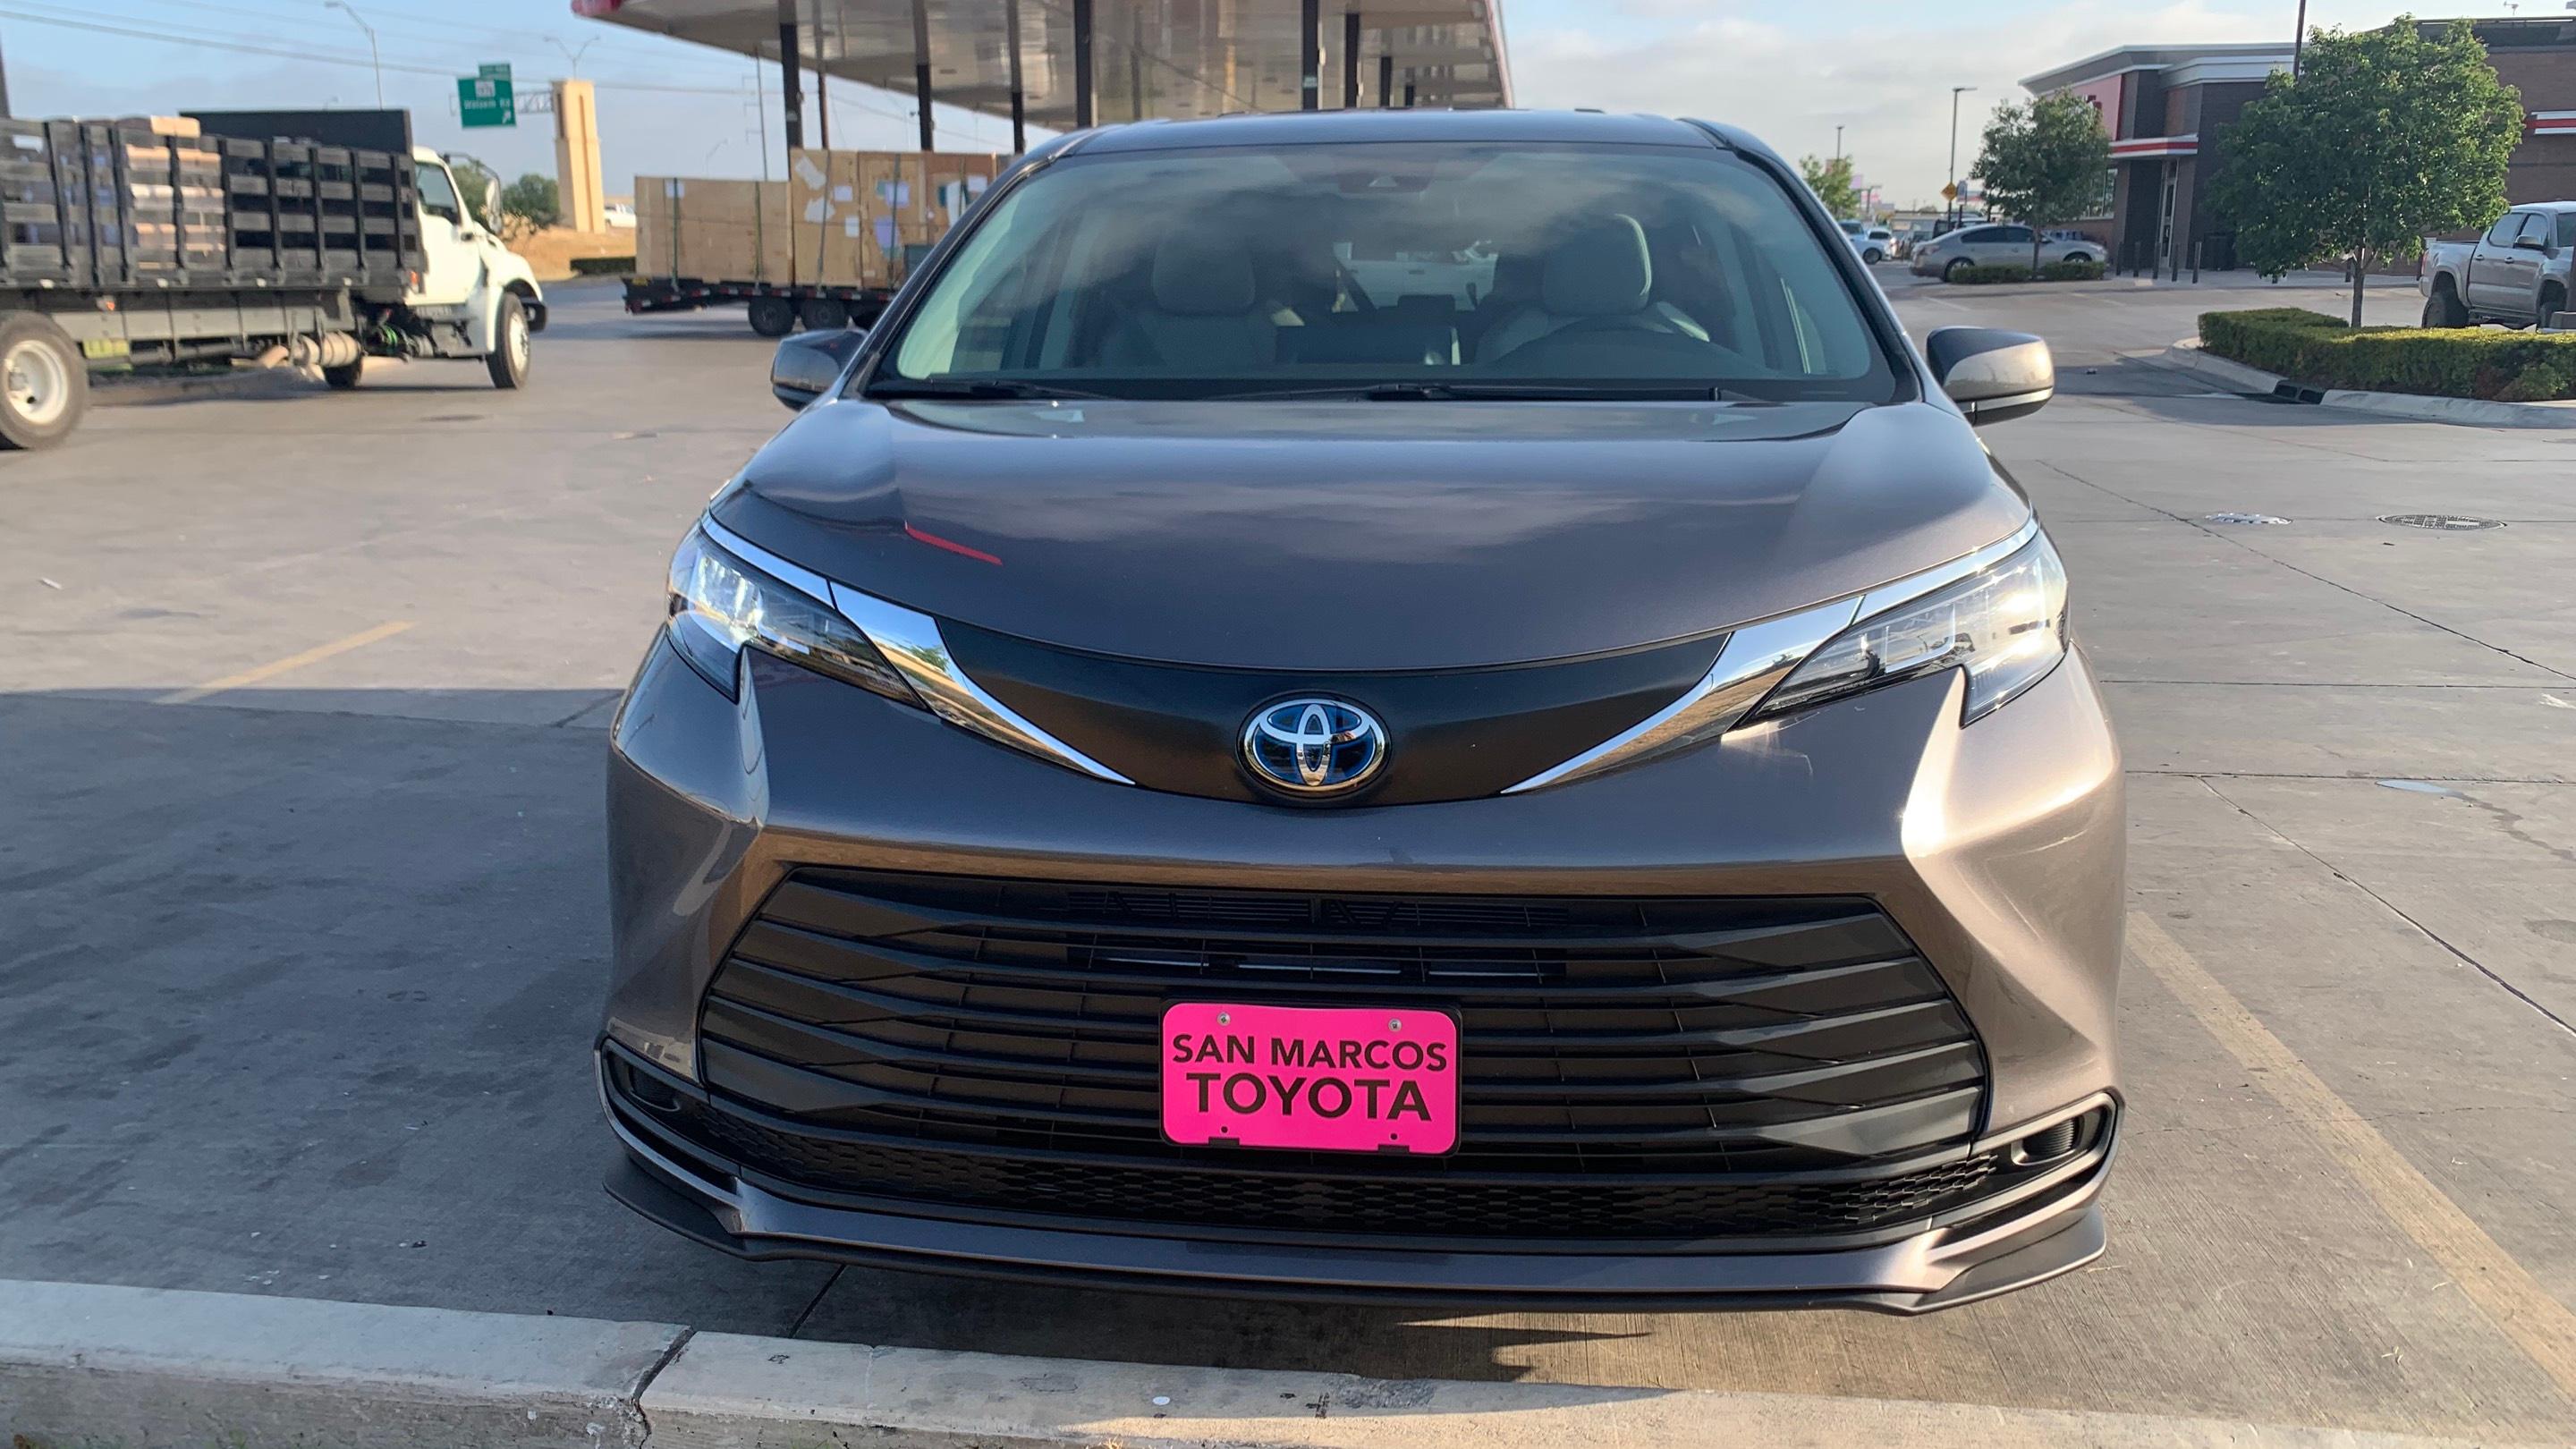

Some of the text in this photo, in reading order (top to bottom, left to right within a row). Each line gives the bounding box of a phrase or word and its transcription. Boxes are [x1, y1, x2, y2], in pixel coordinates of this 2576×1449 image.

[1173, 1034, 1447, 1072] SAN MARCOS
[1186, 1072, 1432, 1122] TOYOTA
